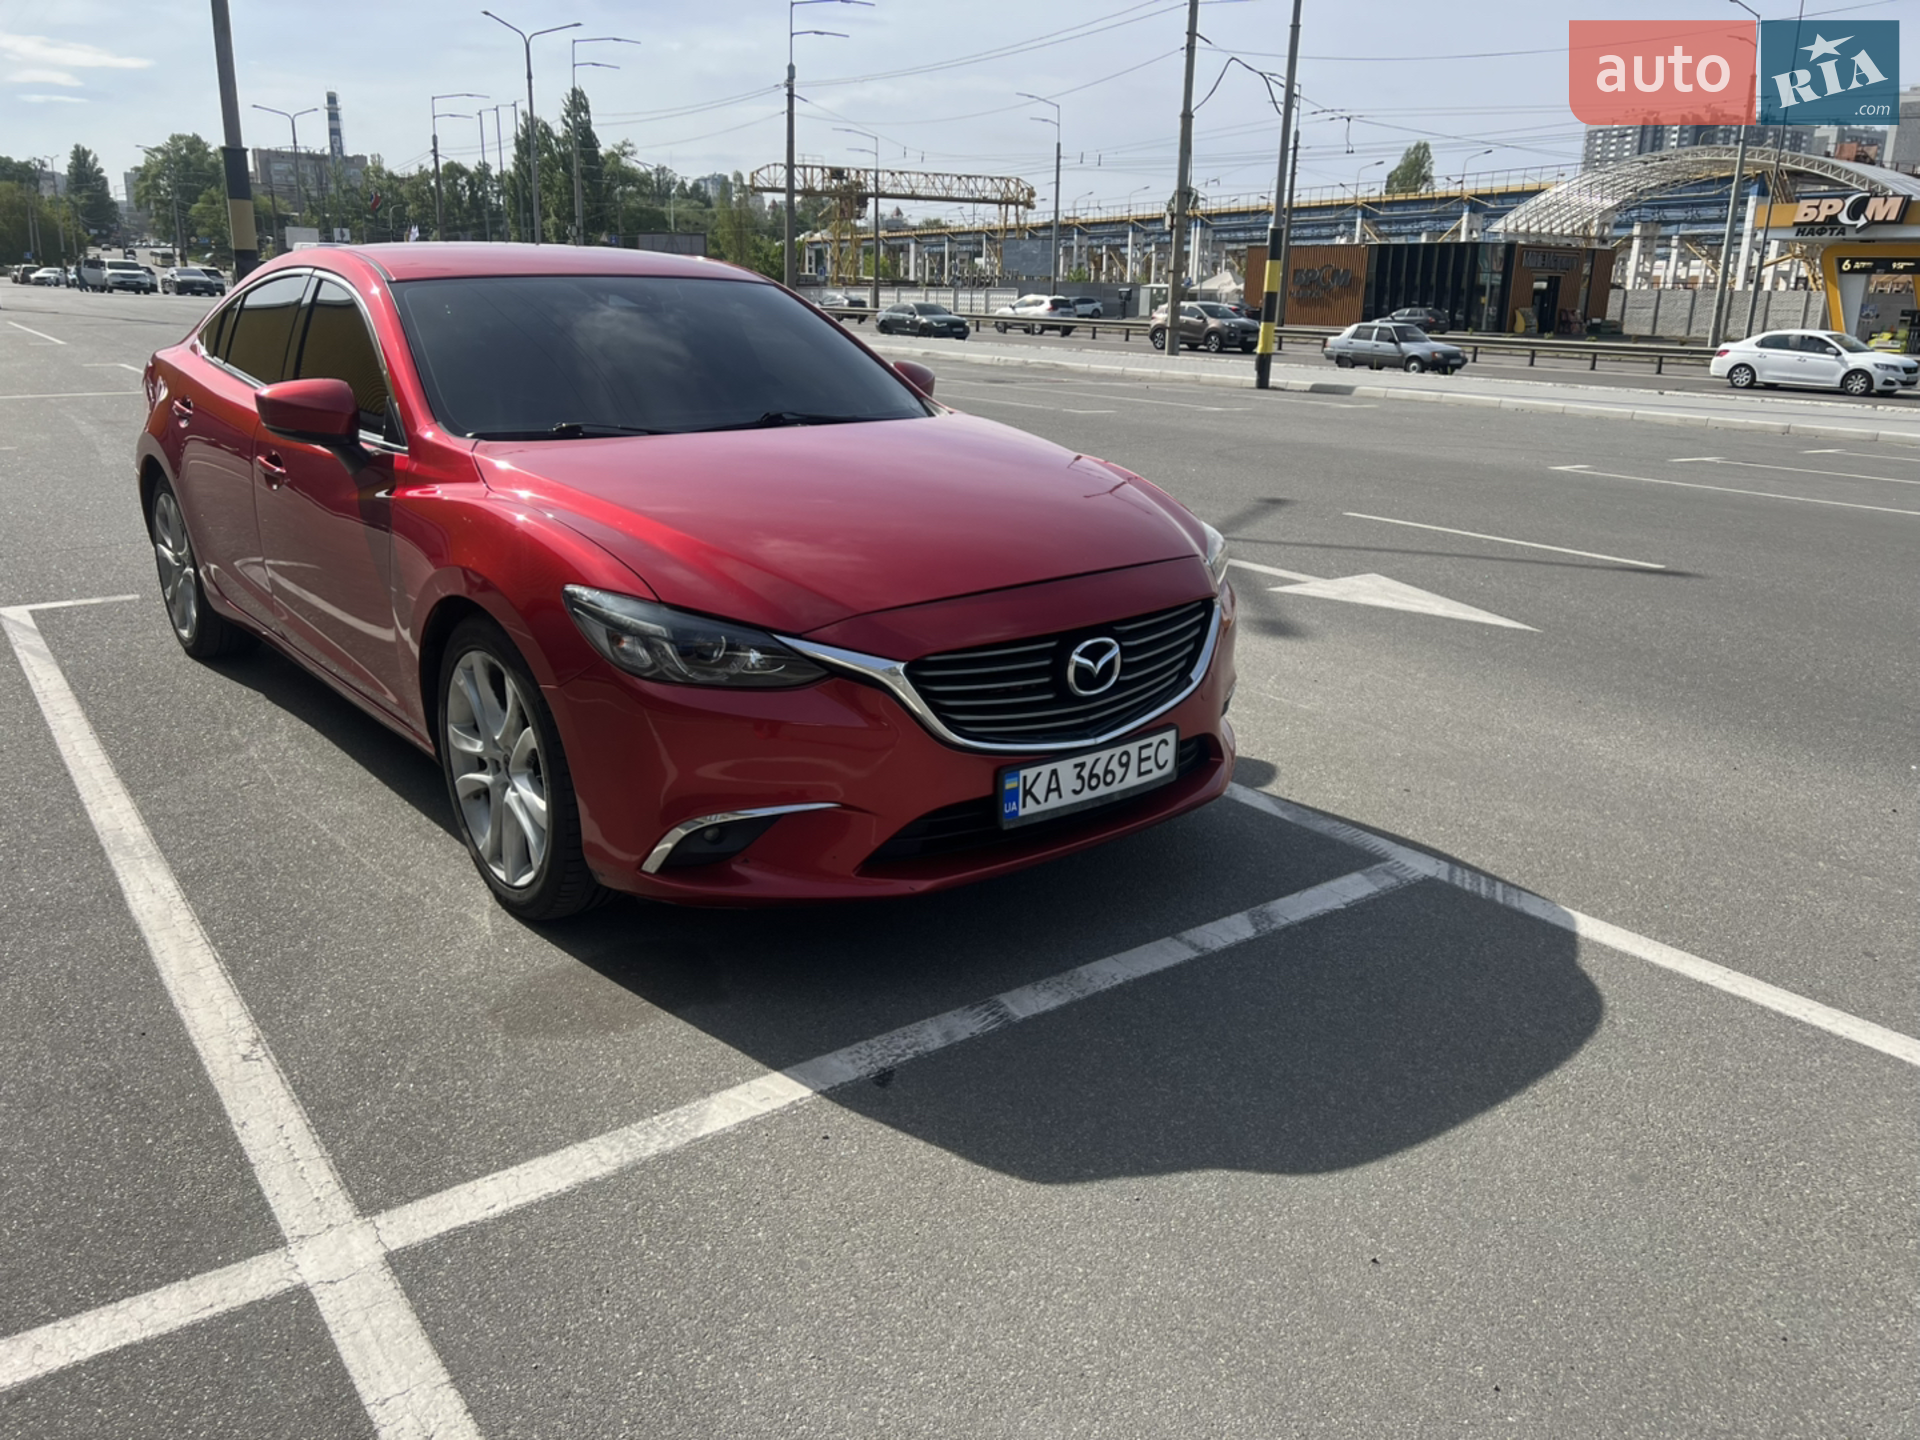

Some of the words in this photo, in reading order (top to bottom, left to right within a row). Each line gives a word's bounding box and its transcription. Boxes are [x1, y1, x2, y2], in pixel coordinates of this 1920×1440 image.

[1795, 227, 1846, 237] НАФТА
[1841, 259, 1852, 271] 6
[1071, 750, 1131, 796] 3669
[1004, 800, 1018, 814] UA
